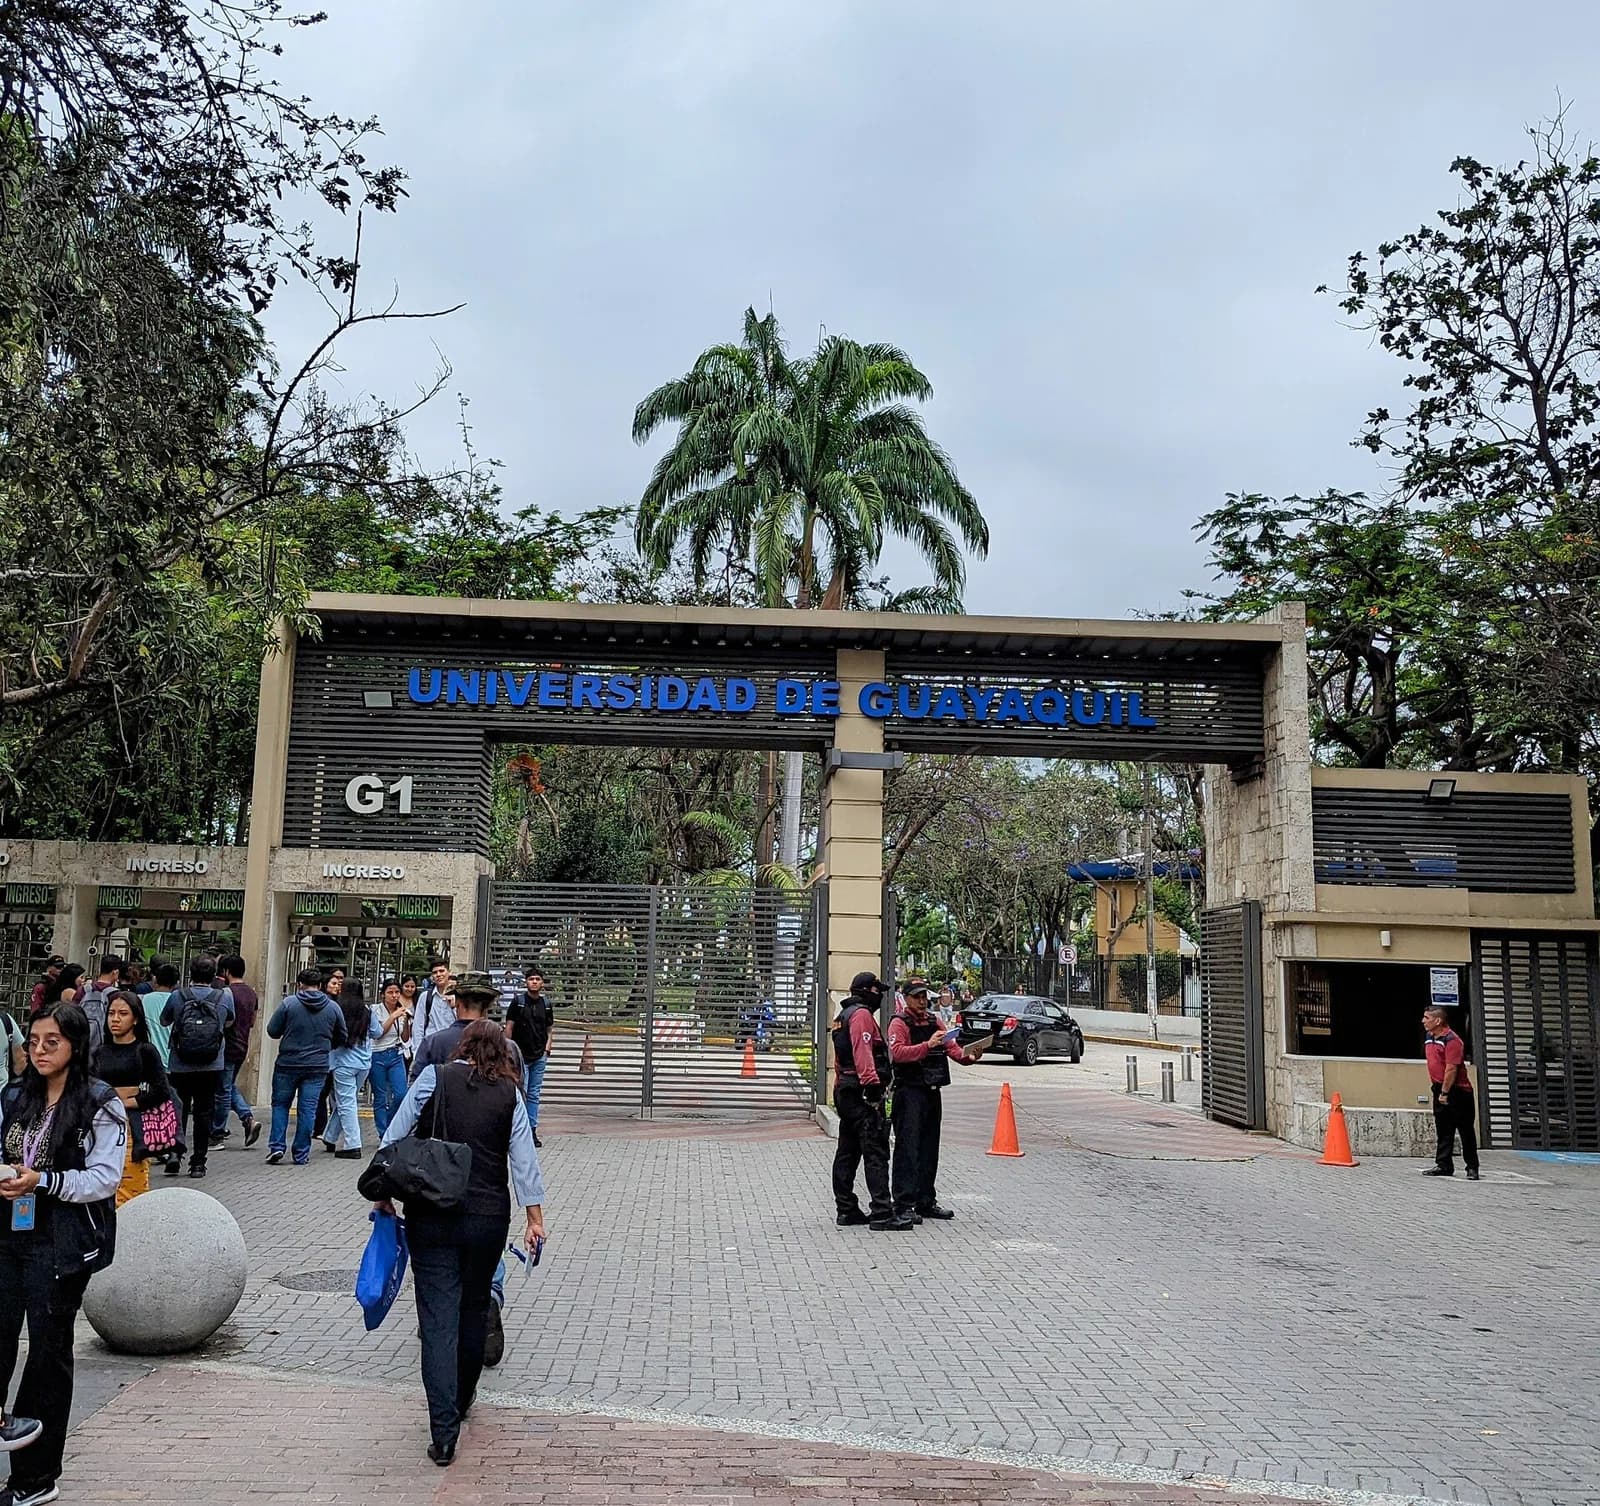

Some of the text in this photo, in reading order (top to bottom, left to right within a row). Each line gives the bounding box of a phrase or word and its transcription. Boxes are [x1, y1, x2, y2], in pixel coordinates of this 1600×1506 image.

[407, 667, 1157, 727] UNIVERSIDAD DE GUAYAQUIL
[345, 775, 413, 814] G1
[126, 857, 209, 874] INGRESO
[322, 863, 406, 880] INGRESO
[5, 884, 48, 905] INGRESO
[99, 887, 142, 908] INGRESO
[201, 892, 244, 912] INGRESO
[295, 893, 338, 914] INGRESO
[397, 896, 440, 917] INGRESO
[1065, 950, 1072, 959] E
[143, 1120, 177, 1145] GIVE UP
